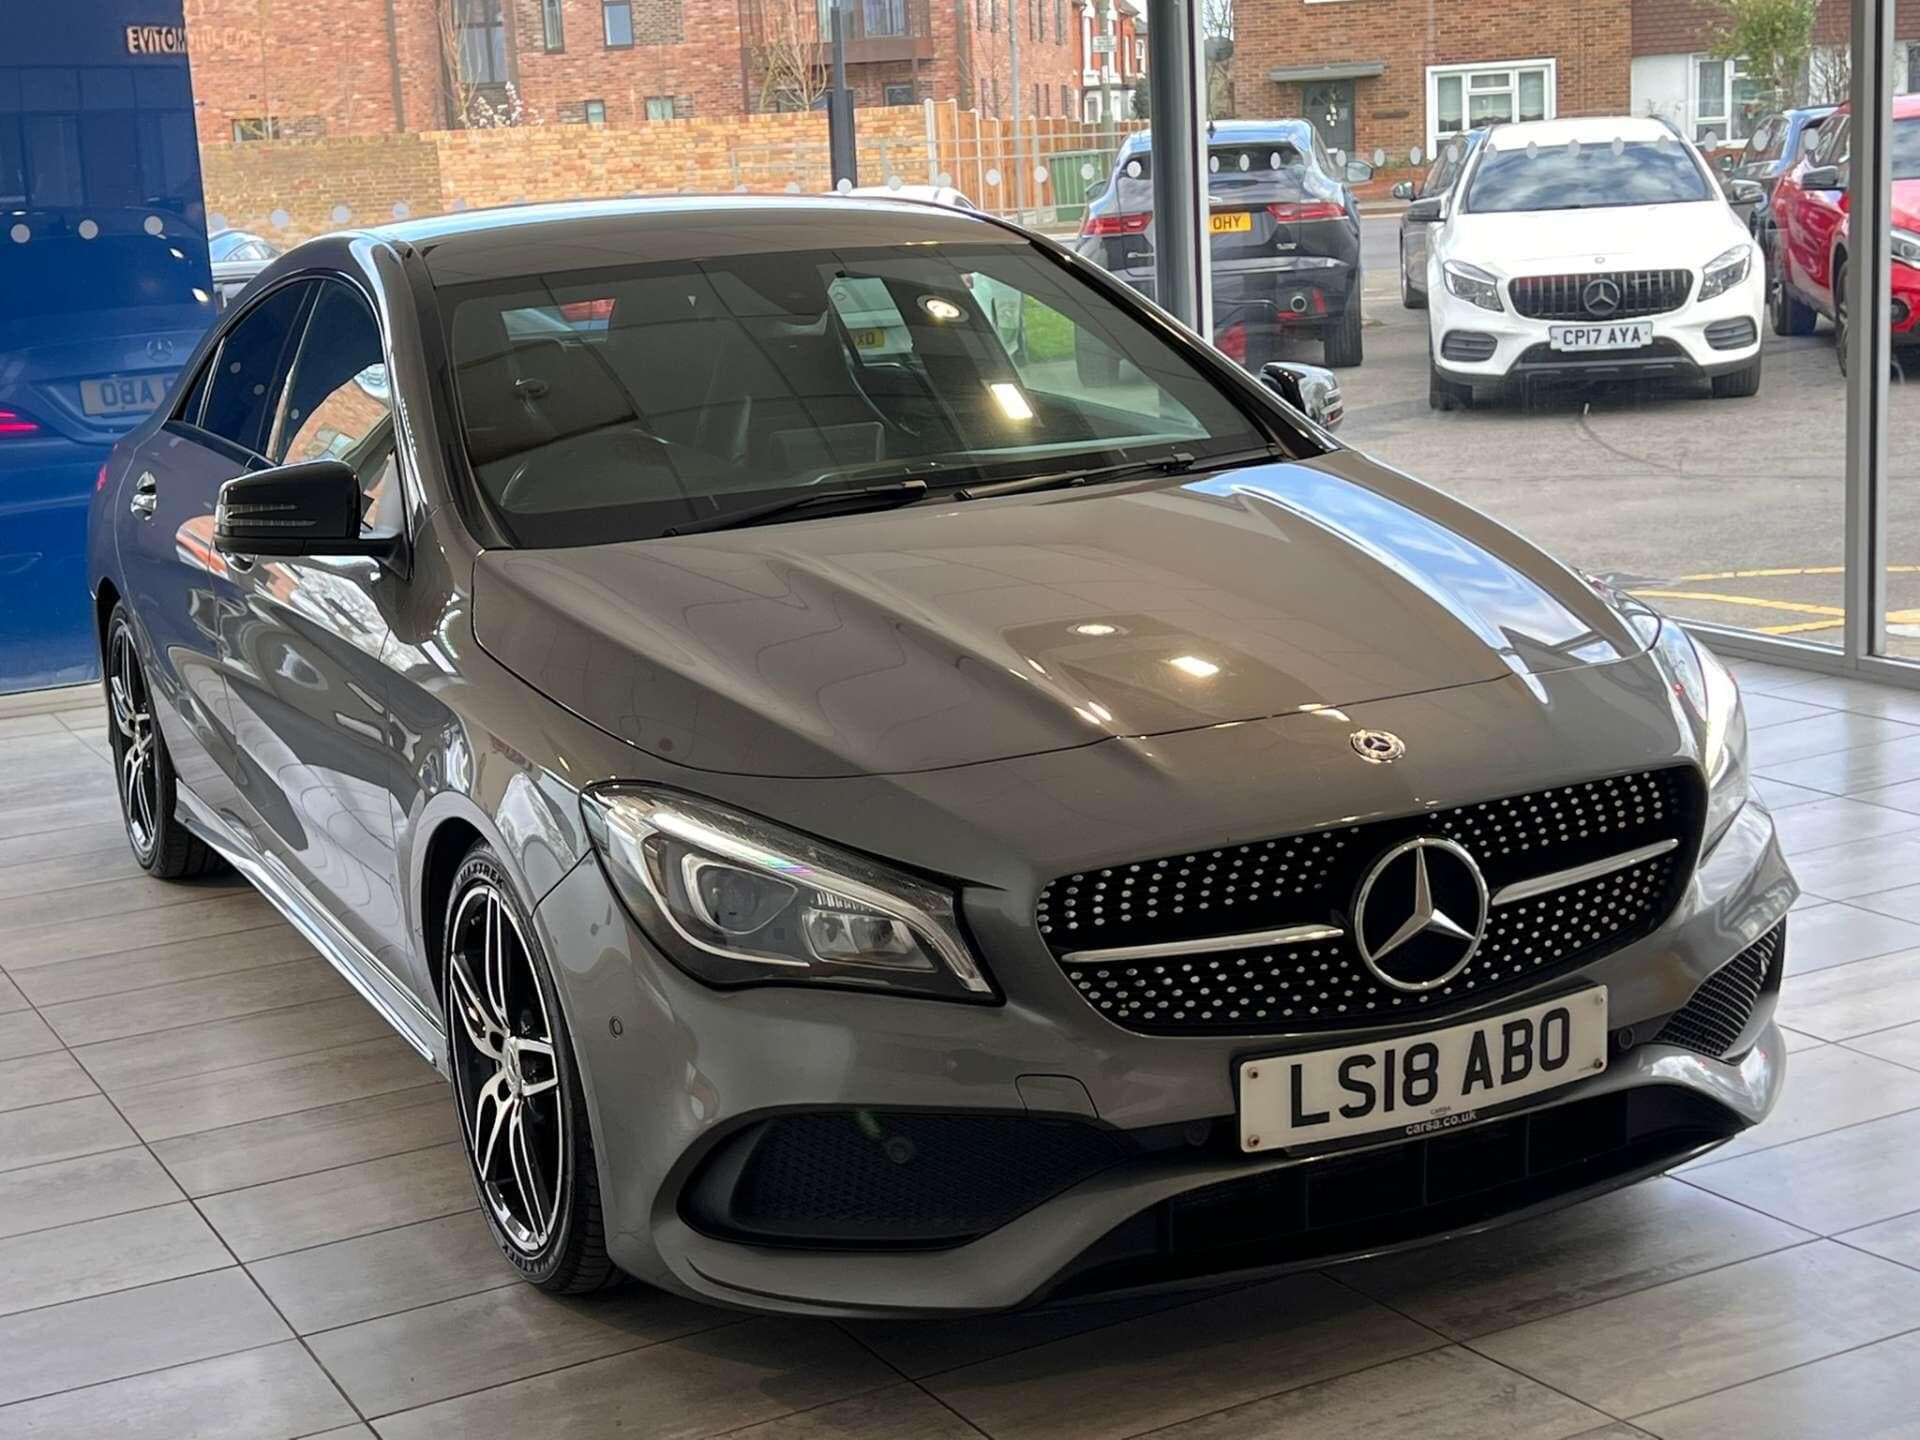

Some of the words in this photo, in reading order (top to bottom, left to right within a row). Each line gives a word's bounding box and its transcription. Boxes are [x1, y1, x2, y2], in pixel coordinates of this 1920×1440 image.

[1213, 215, 1241, 230] OHY
[1563, 328, 1602, 346] CP17
[1607, 326, 1641, 344] AYA
[1290, 1042, 1440, 1128] LS18
[1461, 1006, 1571, 1096] ABO
[1405, 1110, 1478, 1136] carsa.co.uk
